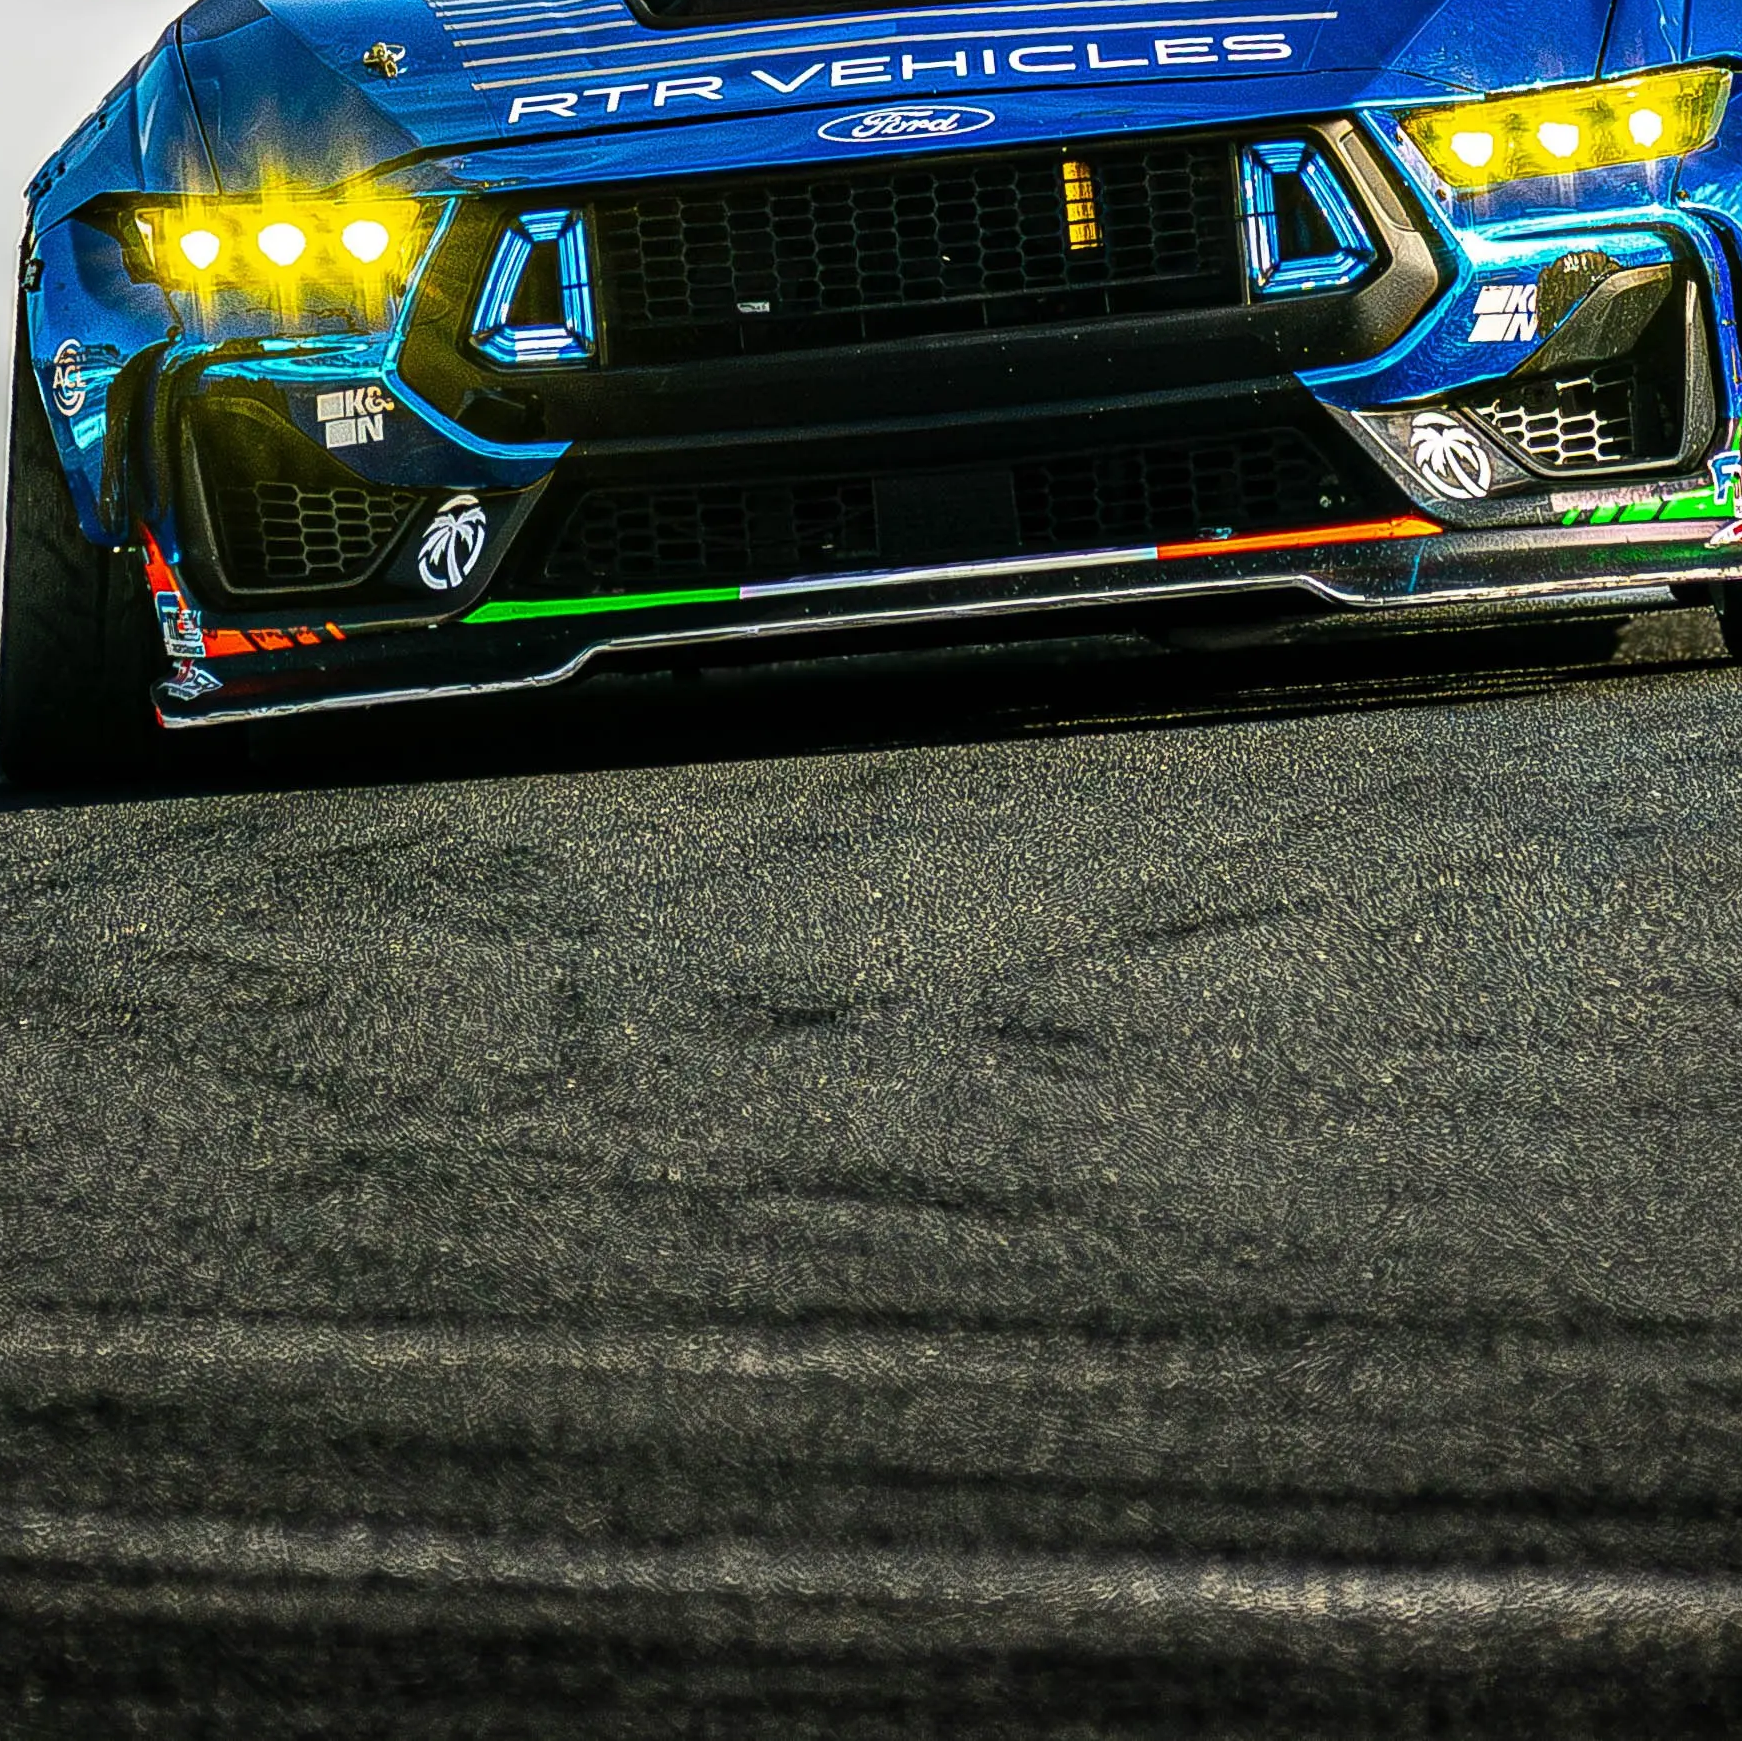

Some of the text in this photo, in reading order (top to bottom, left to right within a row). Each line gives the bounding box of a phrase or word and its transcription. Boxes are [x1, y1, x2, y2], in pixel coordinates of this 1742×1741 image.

[507, 33, 1293, 124] RTR VEHICLES
[851, 110, 961, 138] Ford
